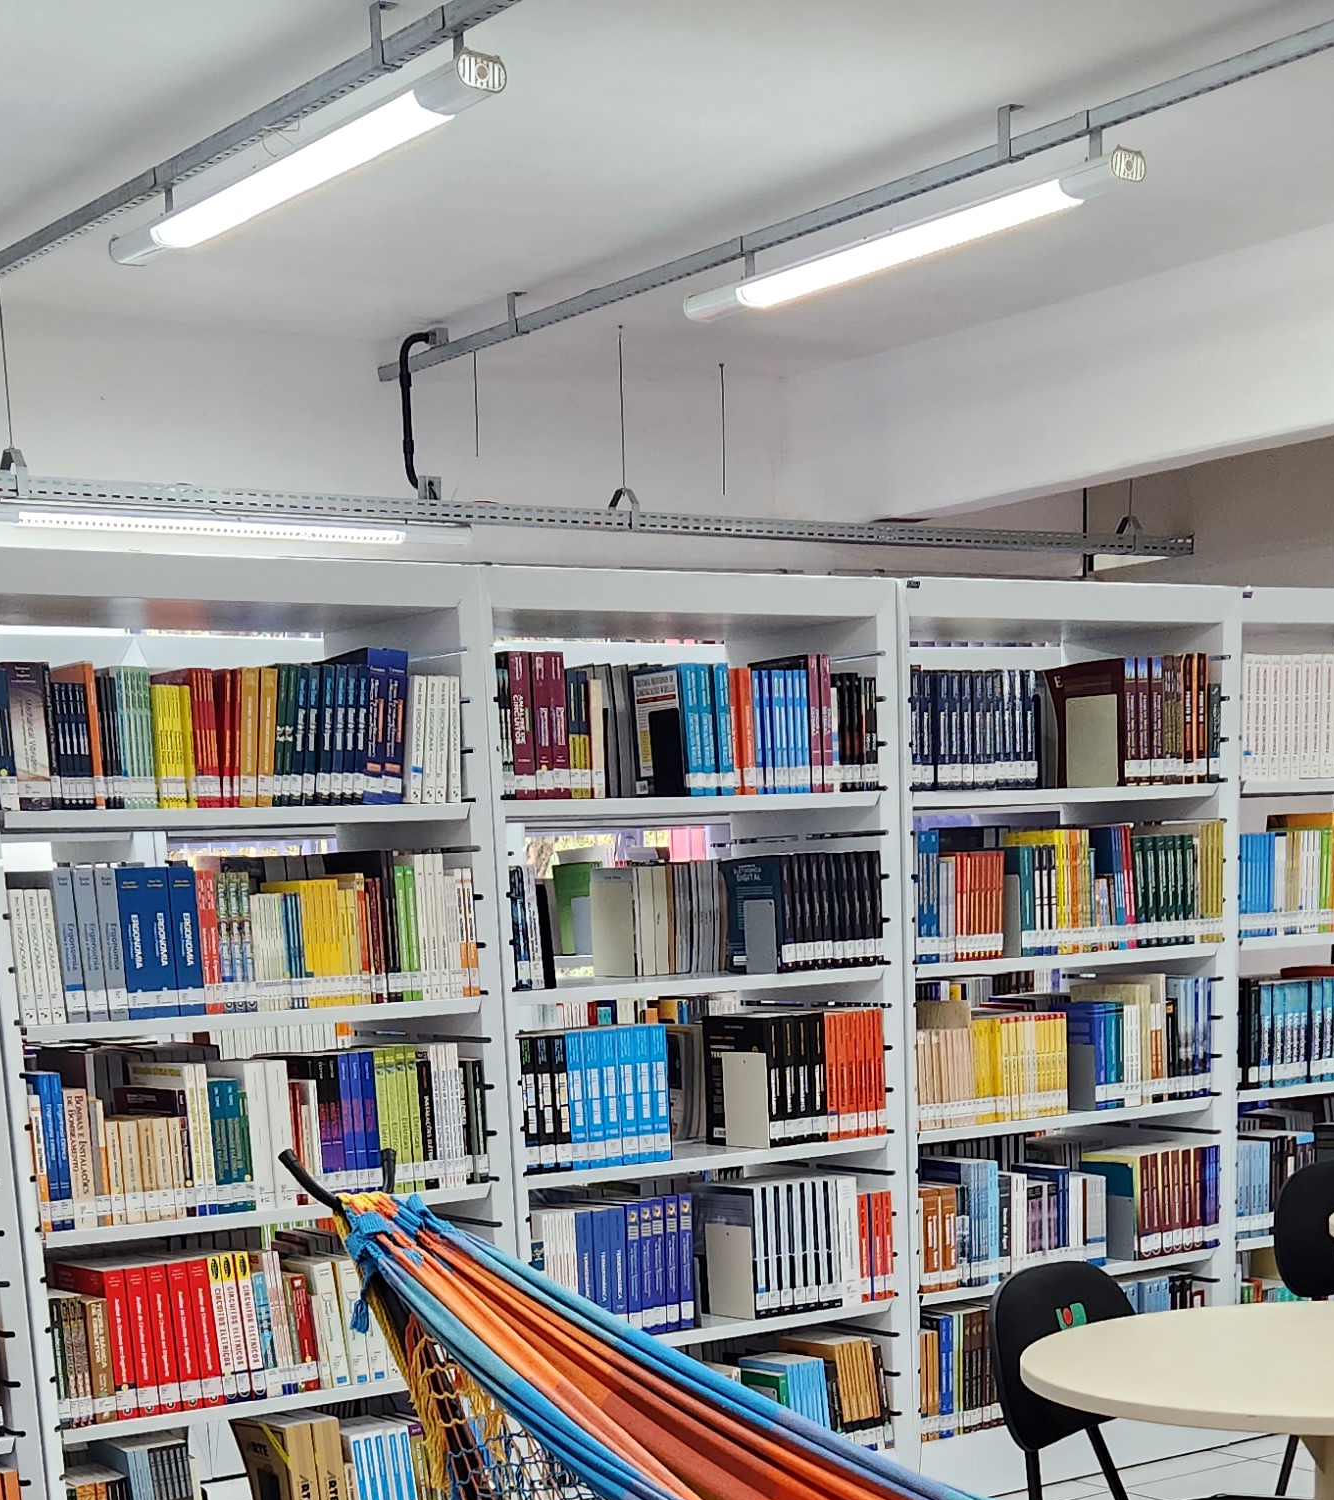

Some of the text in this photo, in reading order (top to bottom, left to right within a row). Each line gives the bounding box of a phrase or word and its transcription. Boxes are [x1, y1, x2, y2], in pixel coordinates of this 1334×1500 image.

[25, 699, 38, 772] Mechanical Vibration
[88, 923, 99, 970] Ergonomia
[109, 923, 120, 970] Ergonomia
[131, 914, 143, 969] ERGONOMIA
[156, 912, 168, 966] ERGONOMIA
[182, 912, 194, 966] ERGONOMIA
[74, 1095, 85, 1131] BOMBAS
[78, 1141, 90, 1194] INSTALAÇÕES
[214, 1288, 227, 1326] CIRCUITOS
[99, 1336, 107, 1368] BÁSICA
